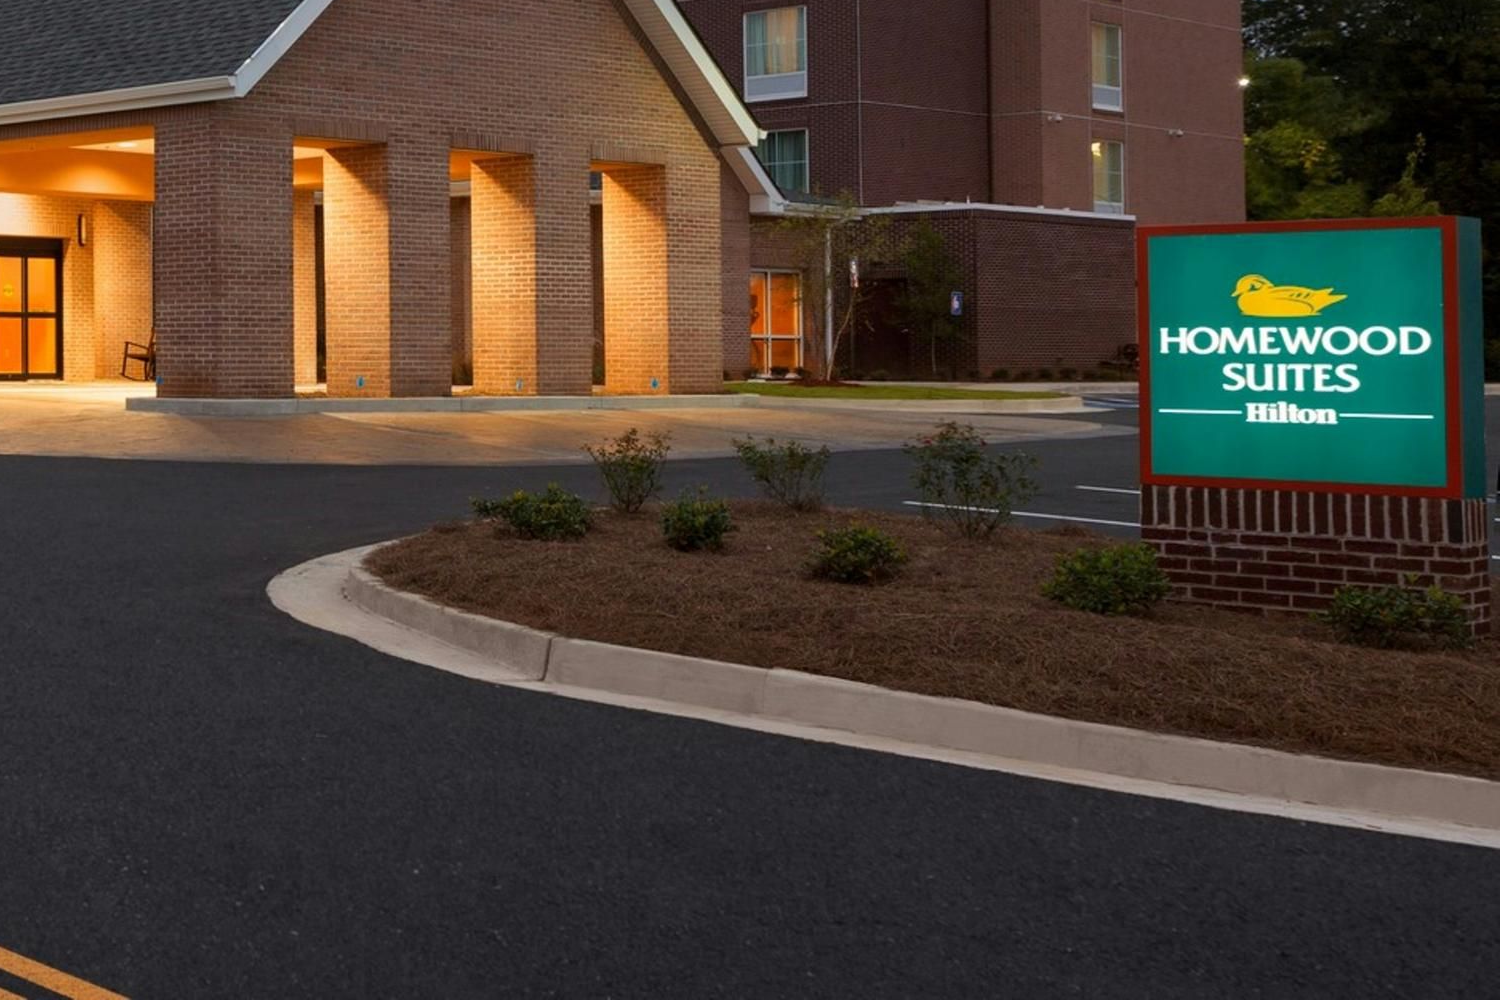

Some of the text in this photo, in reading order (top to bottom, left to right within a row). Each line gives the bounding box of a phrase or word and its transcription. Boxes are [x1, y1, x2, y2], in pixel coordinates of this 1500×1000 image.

[1160, 326, 1432, 356] HOMEWOOD
[1222, 363, 1361, 393] SUITES
[1245, 401, 1338, 425] Hilton
